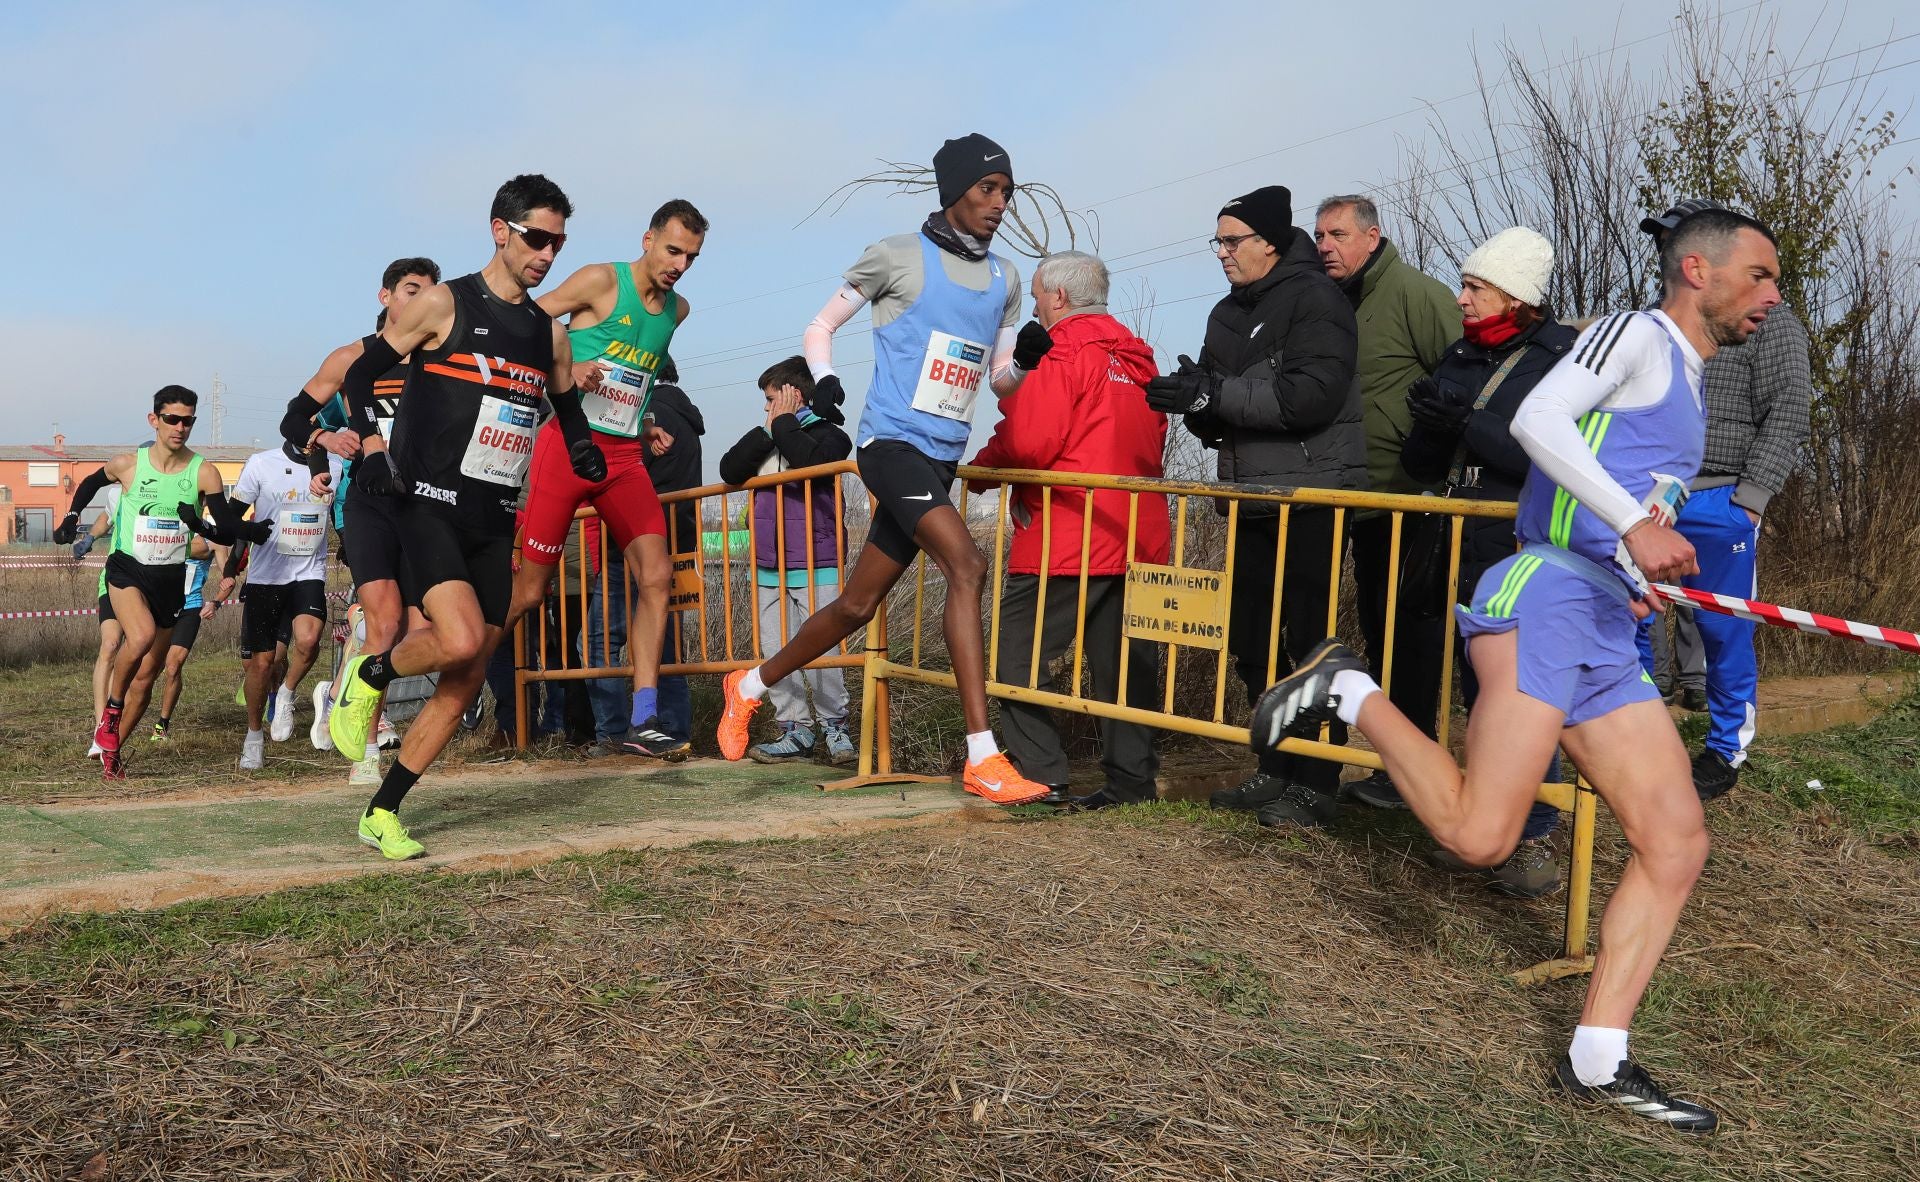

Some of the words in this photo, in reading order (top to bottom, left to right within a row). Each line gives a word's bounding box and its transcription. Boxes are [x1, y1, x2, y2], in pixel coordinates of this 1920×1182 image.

[509, 366, 546, 387] VICKY
[510, 382, 540, 397] FOOD
[490, 469, 517, 480] CEREALTO
[414, 481, 457, 506] 226ERS
[281, 527, 325, 536] HERNANDEZ
[1127, 569, 1220, 592] AYUNTAMIENTO
[1163, 598, 1179, 610] DE
[1123, 613, 1160, 630] VENTA
[1163, 619, 1179, 632] DE
[1181, 620, 1223, 639] BAÑOS
